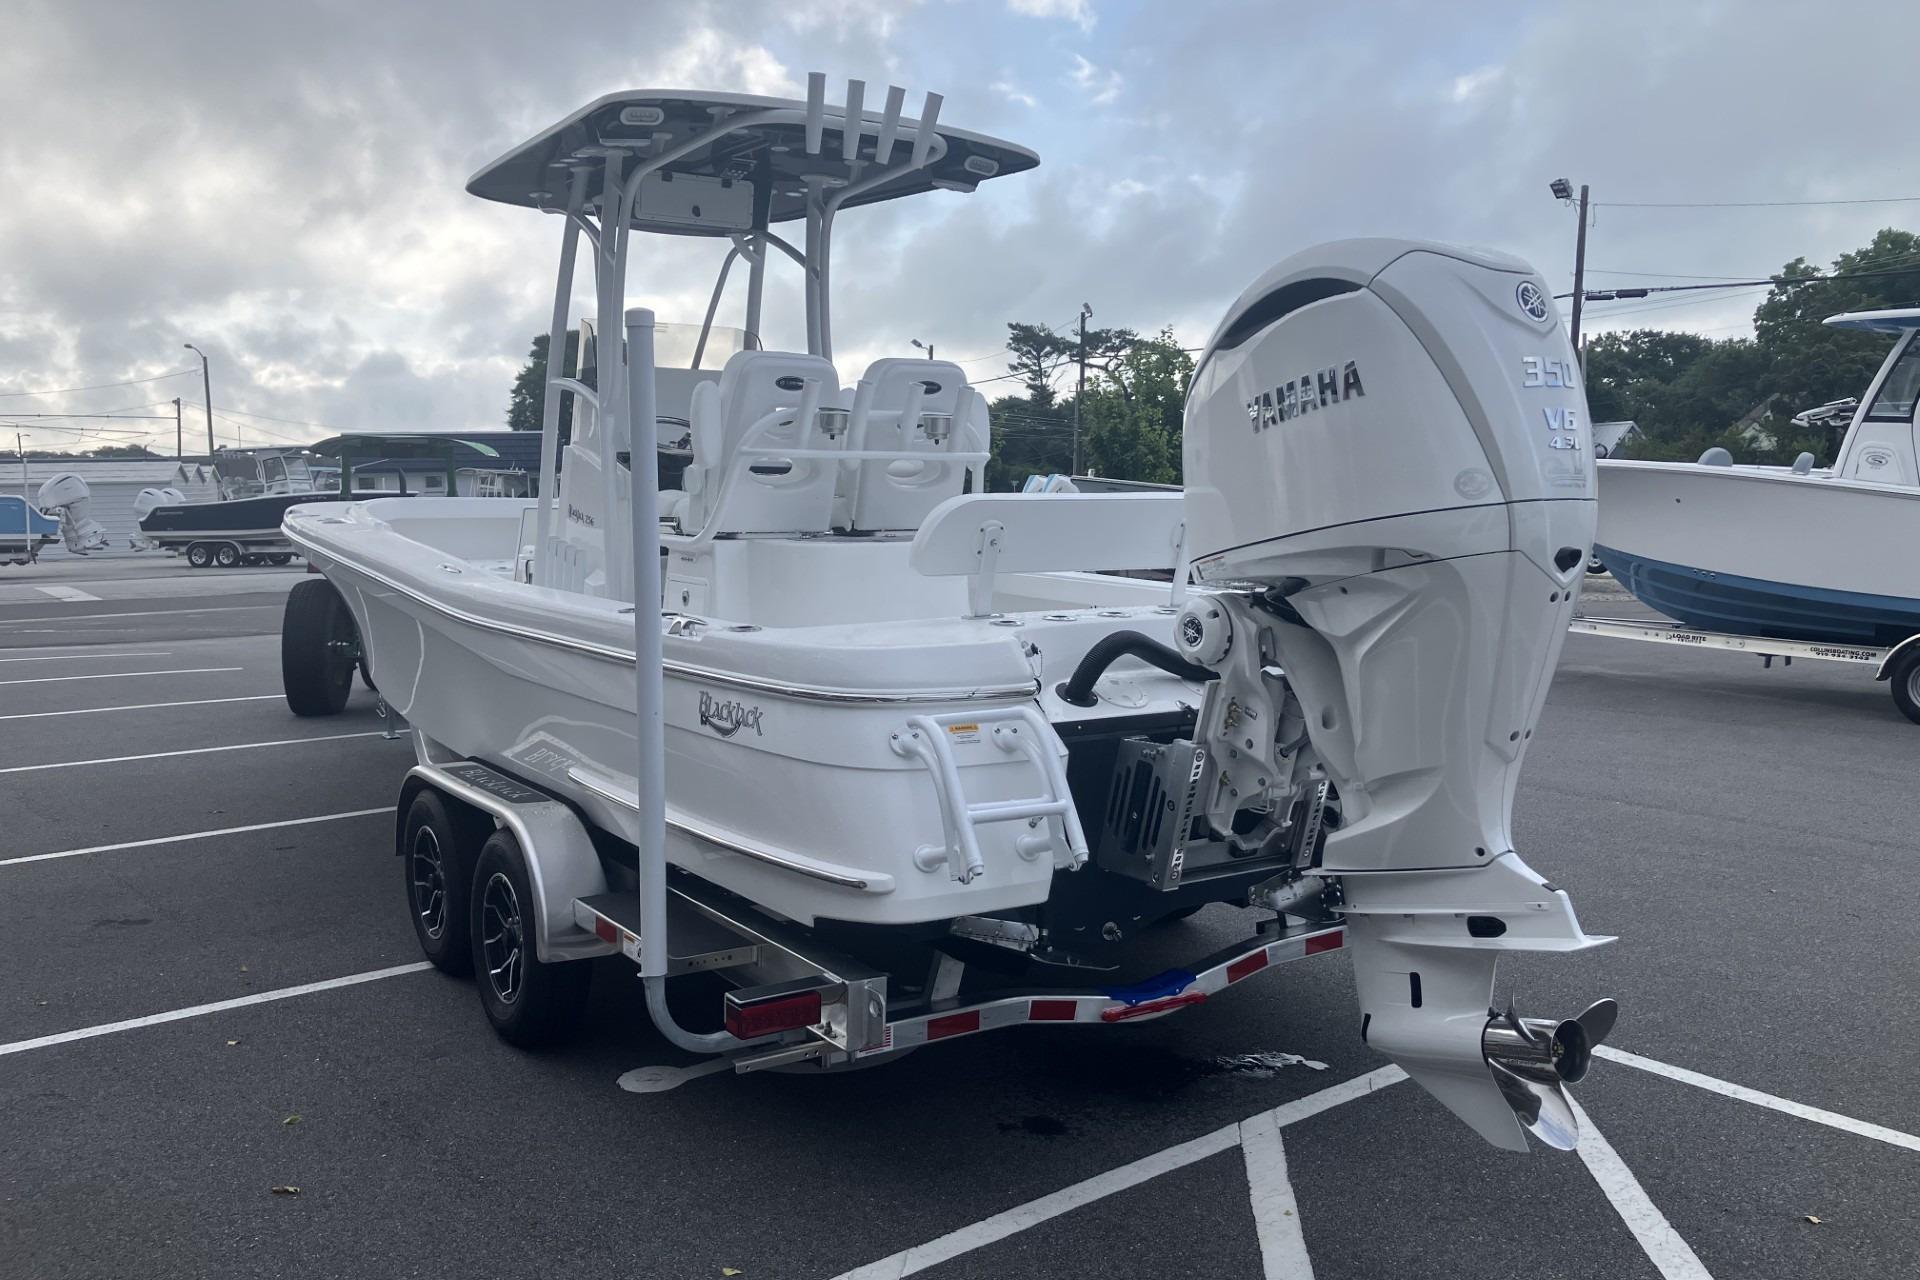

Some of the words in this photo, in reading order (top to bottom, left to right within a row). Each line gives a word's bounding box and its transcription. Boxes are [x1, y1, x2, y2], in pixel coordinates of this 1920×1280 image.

[1521, 356, 1576, 389] 350
[1247, 359, 1366, 434] YAMAHA
[1543, 407, 1577, 430] V6
